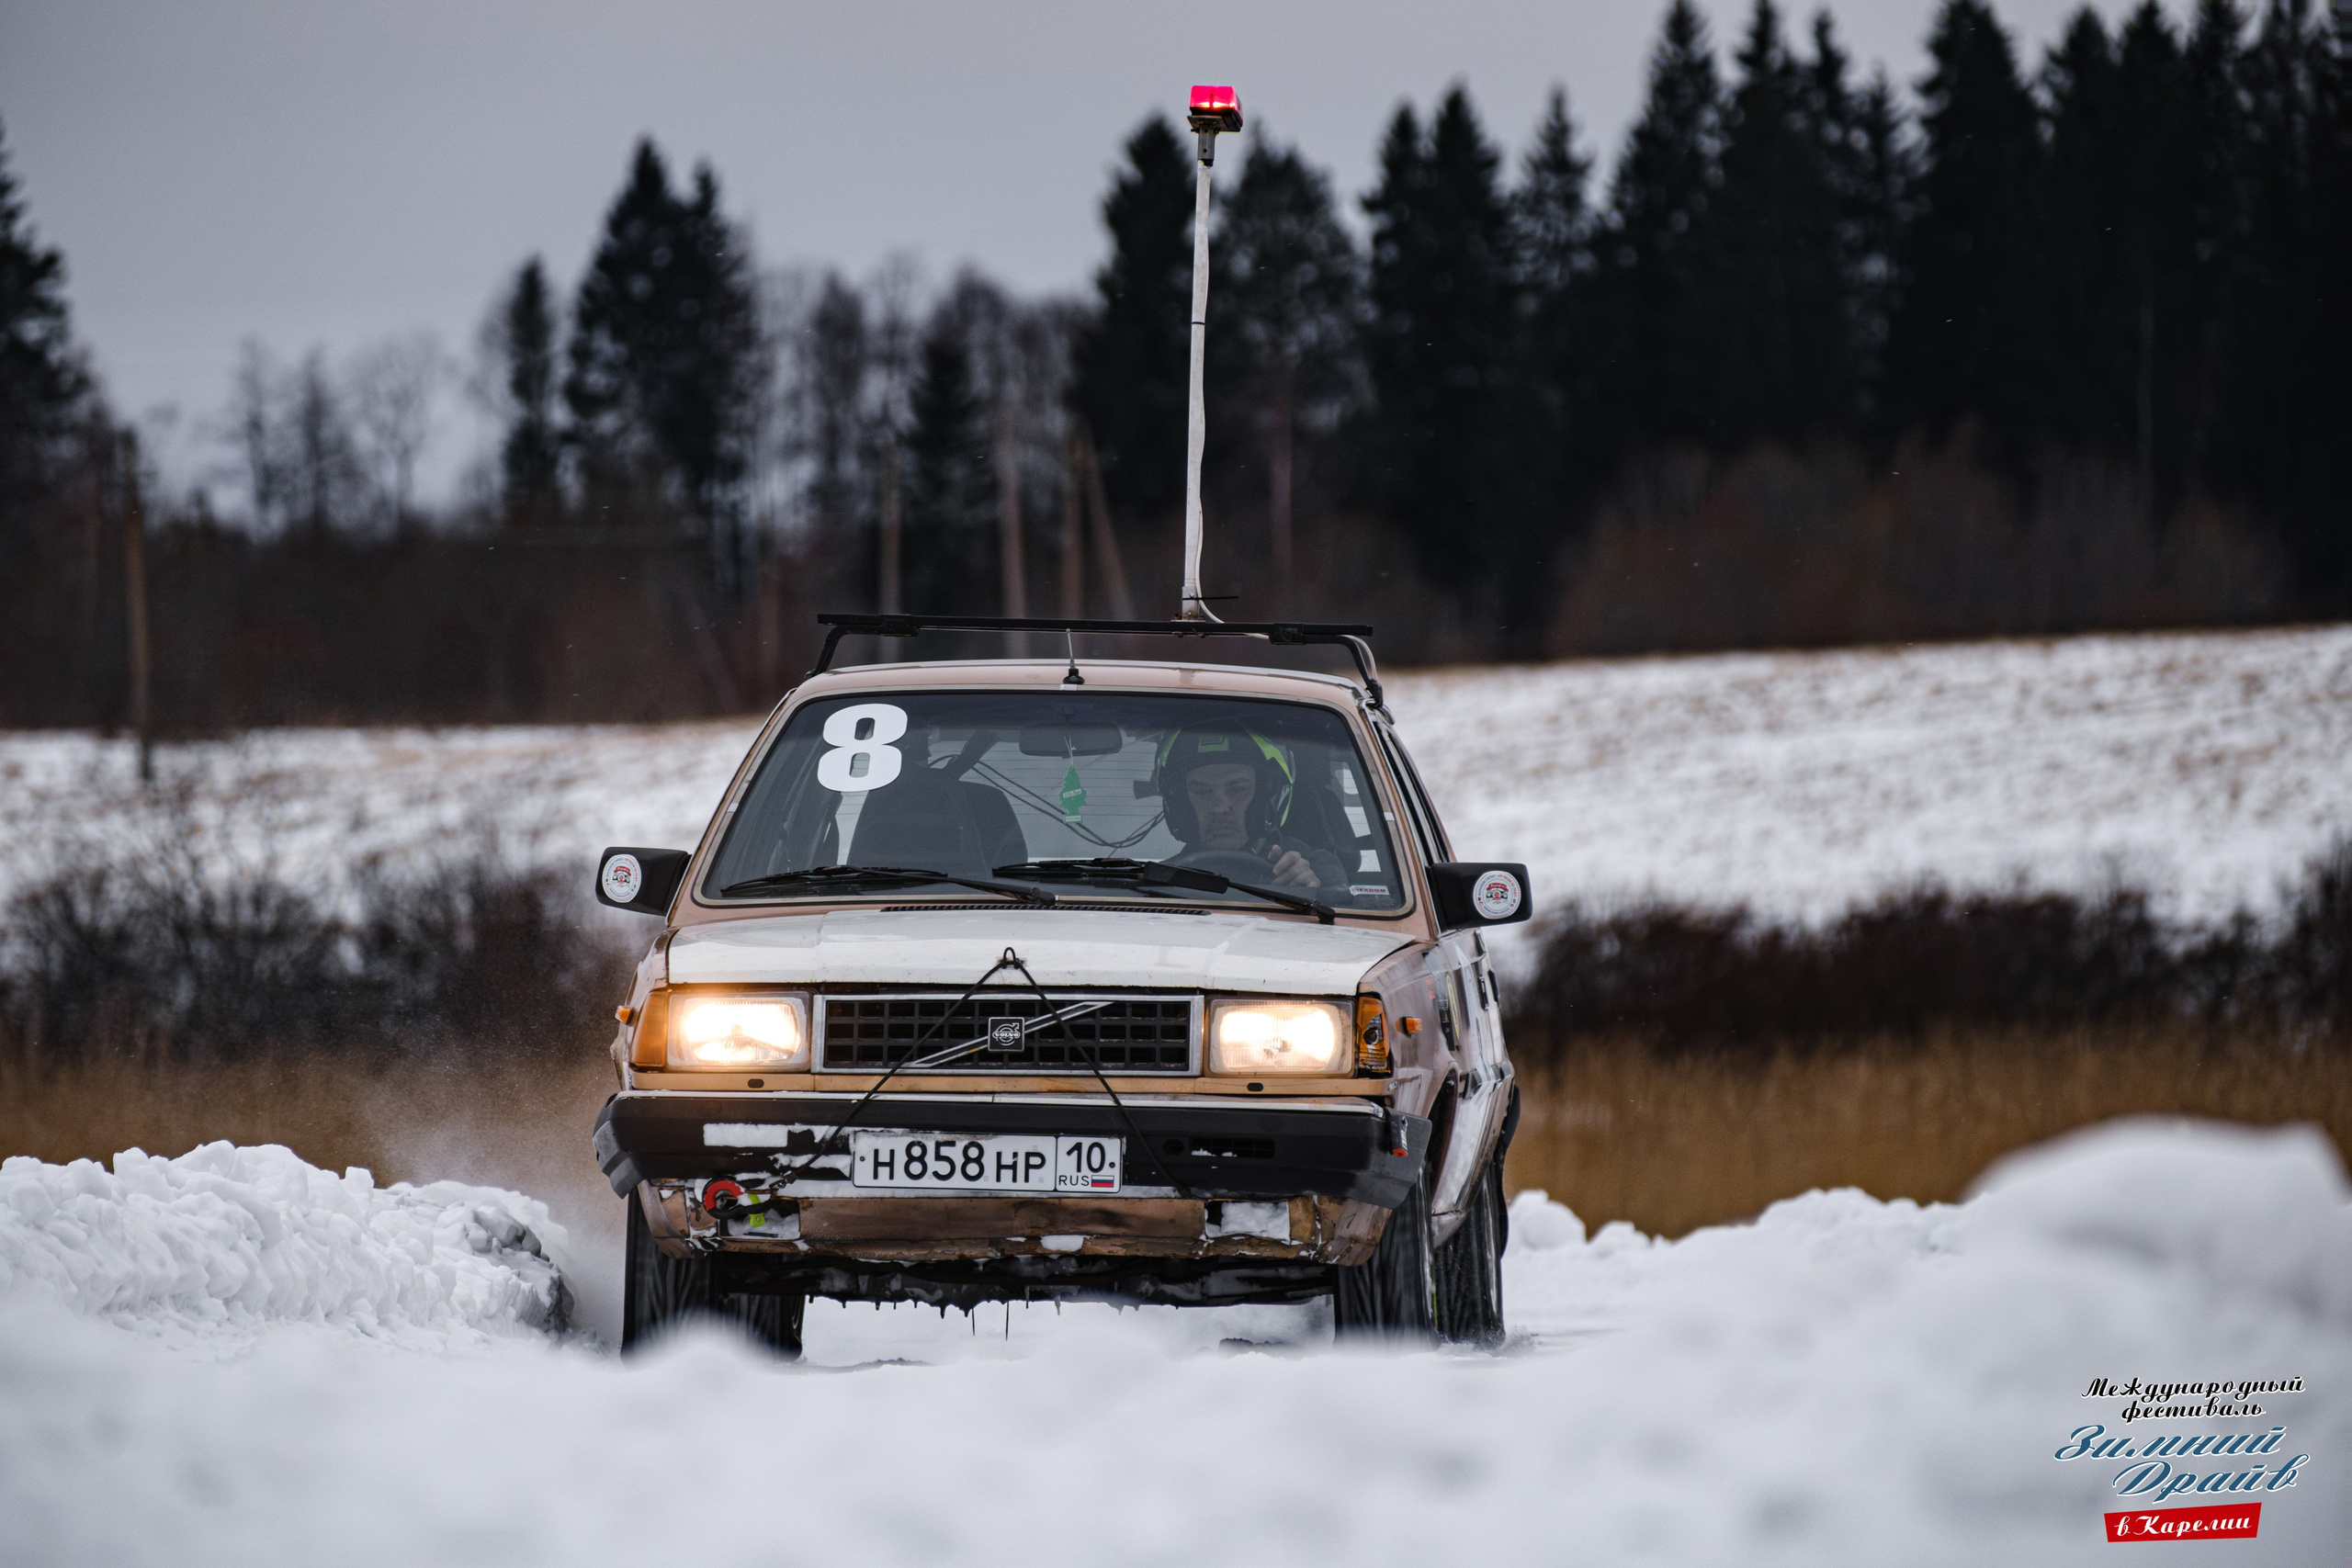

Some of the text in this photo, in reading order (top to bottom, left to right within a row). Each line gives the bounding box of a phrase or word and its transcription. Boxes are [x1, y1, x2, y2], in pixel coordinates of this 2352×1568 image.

[818, 704, 908, 792] 8
[1066, 1142, 1106, 1173] 10
[1058, 1175, 1091, 1187] RUS
